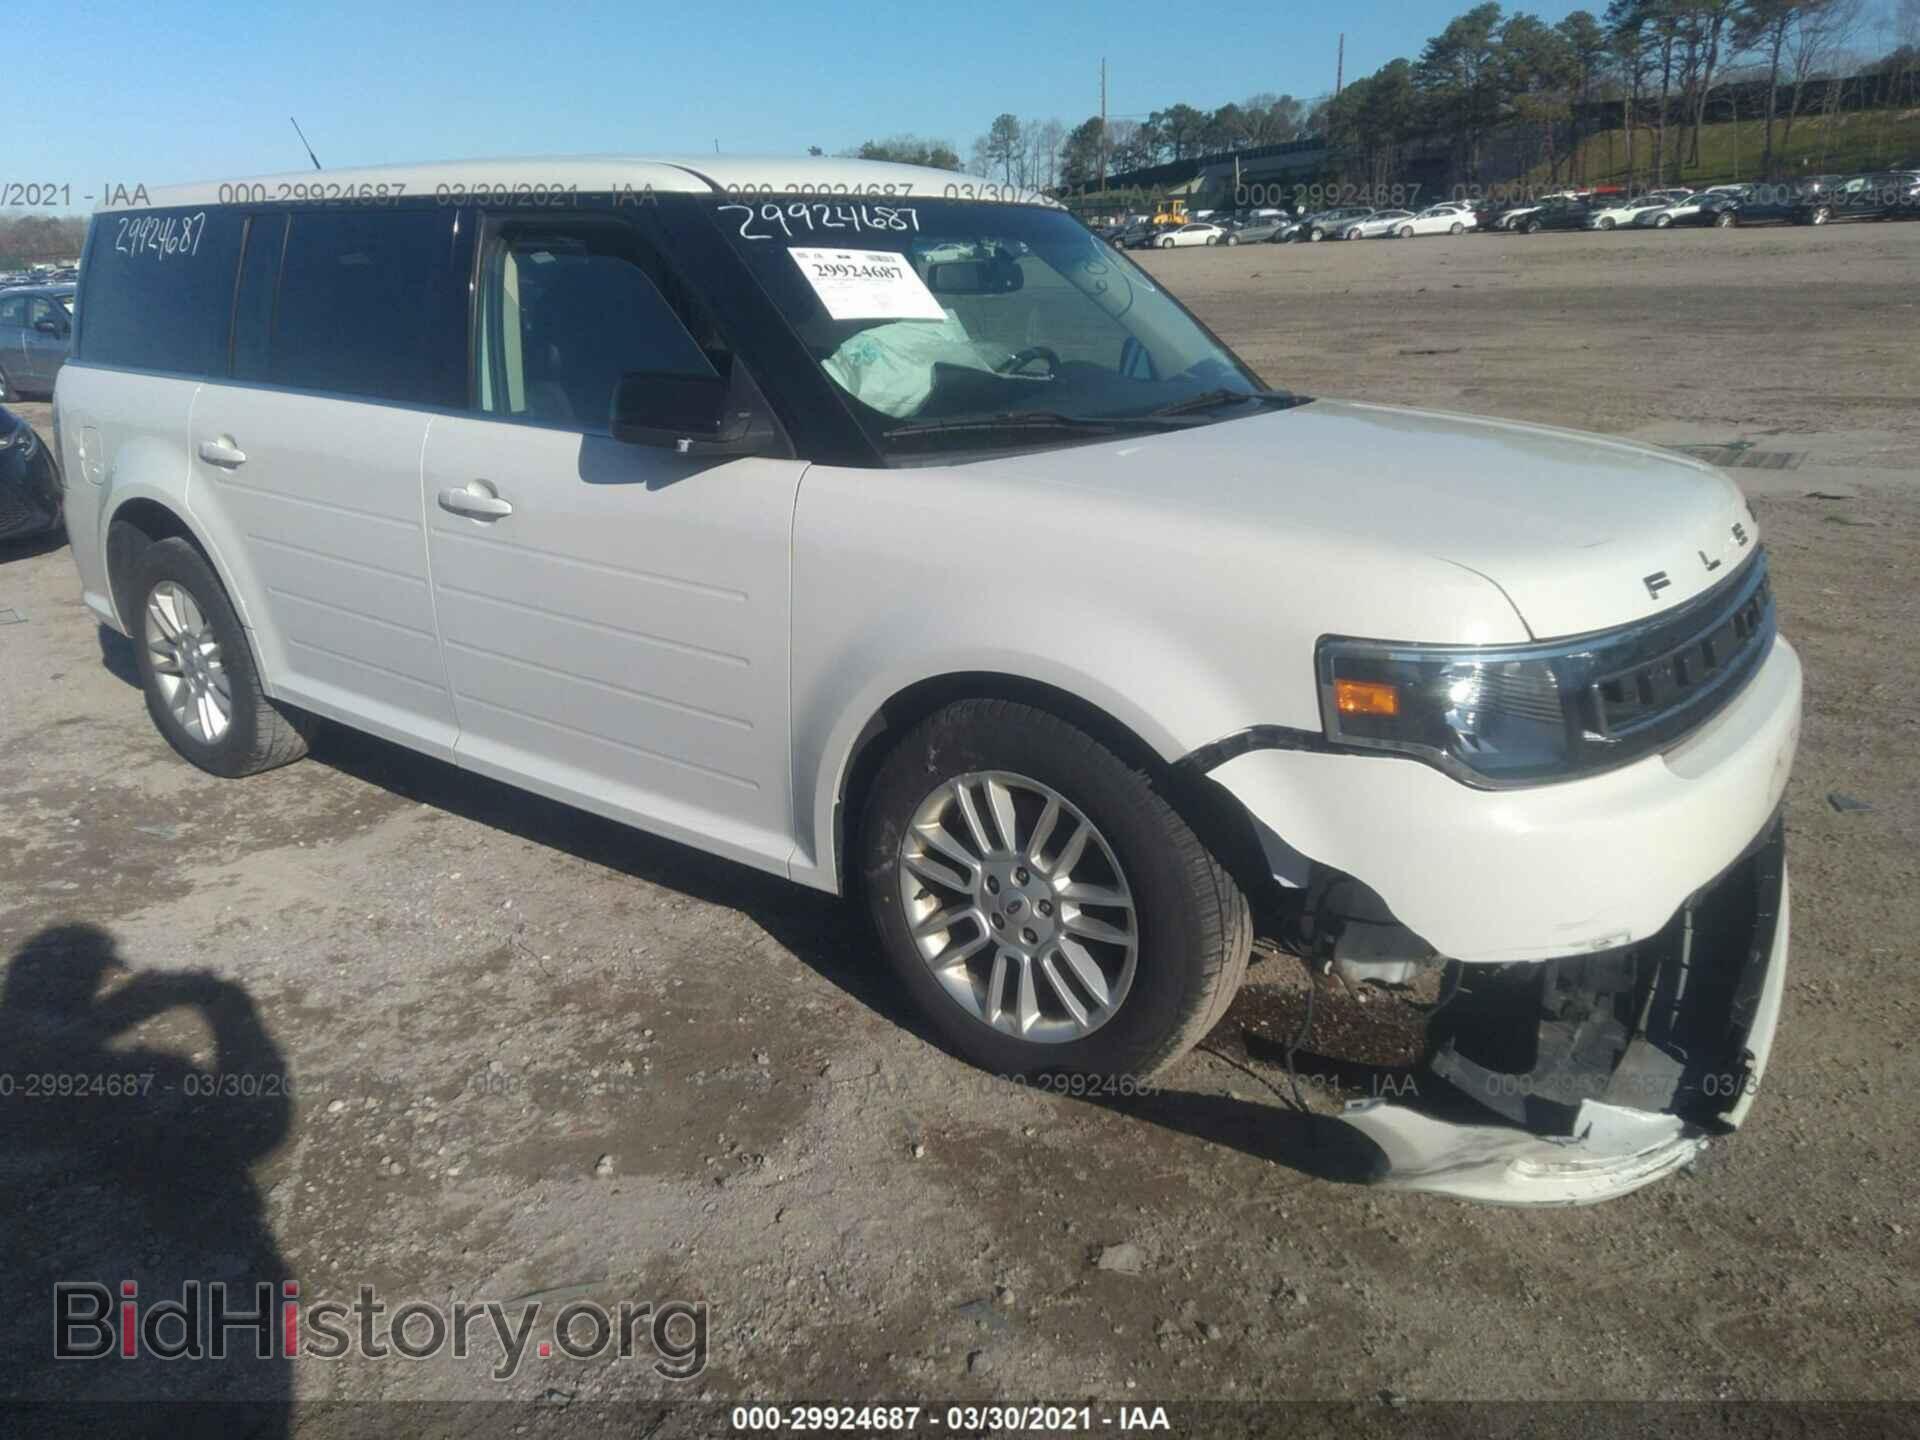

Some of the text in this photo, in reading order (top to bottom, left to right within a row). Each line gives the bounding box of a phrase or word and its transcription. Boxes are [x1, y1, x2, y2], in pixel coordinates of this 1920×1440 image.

[115, 211, 206, 261] 29924687
[718, 203, 920, 239] 29924687
[812, 262, 904, 280] 29924687
